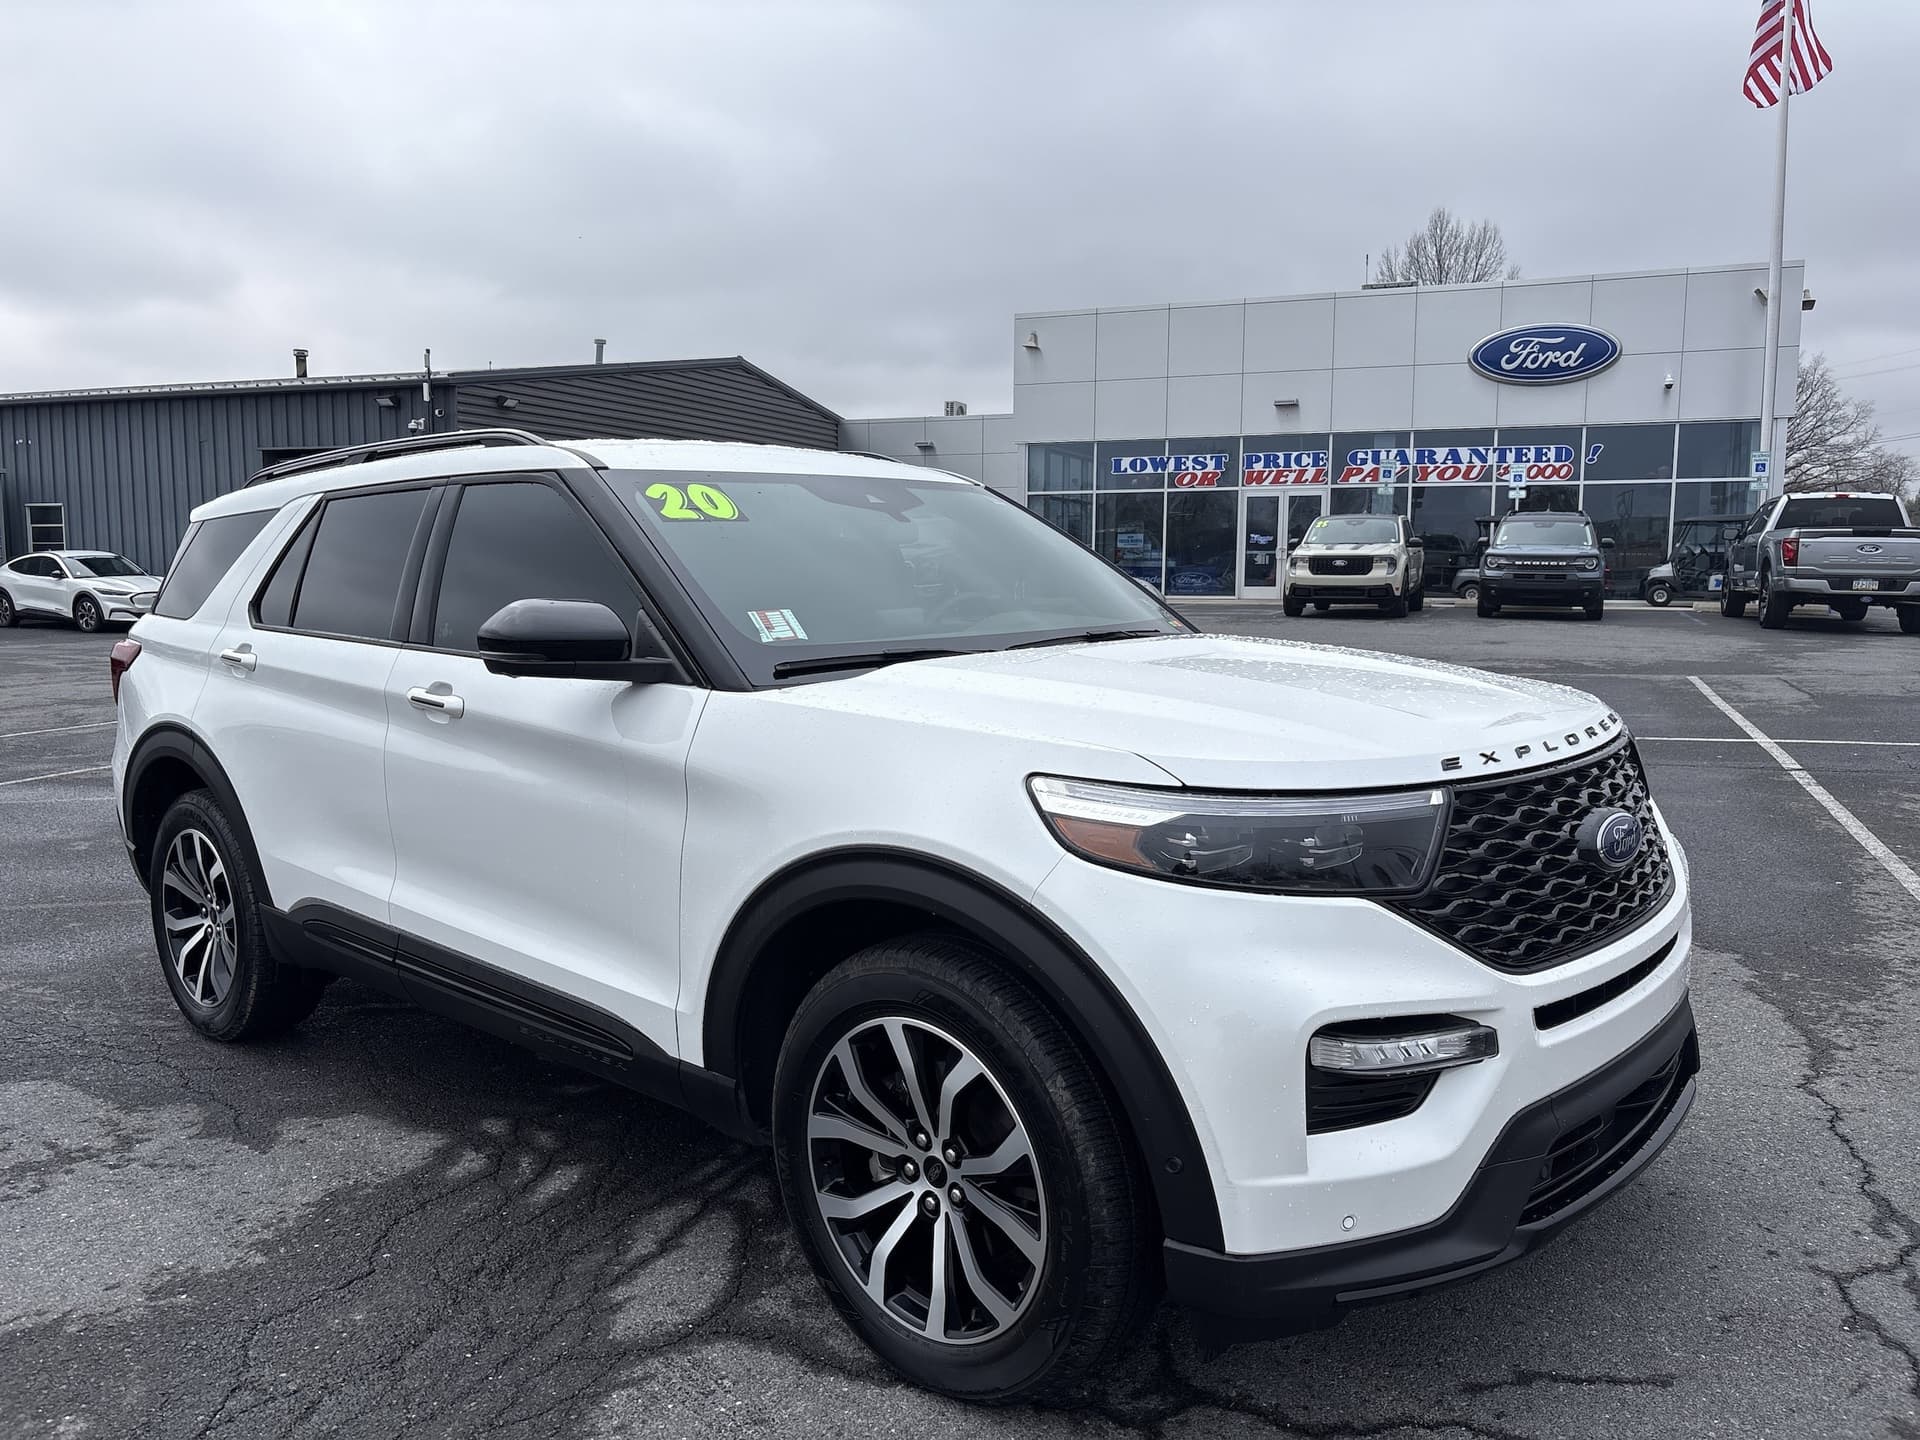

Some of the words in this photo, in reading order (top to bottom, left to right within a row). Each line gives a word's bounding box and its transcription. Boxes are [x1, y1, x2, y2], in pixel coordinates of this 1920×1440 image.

[1500, 336, 1587, 371] Ford
[1111, 454, 1229, 474] LOWEST
[1244, 451, 1328, 470] PRICE
[1347, 446, 1574, 466] GUARANTEED
[1175, 471, 1220, 488] OR
[1244, 468, 1328, 485] WE'LL
[1417, 464, 1487, 482] YOU
[645, 483, 739, 520] 20
[1441, 713, 1618, 772] EXPLORER
[1612, 822, 1638, 856] Ford
